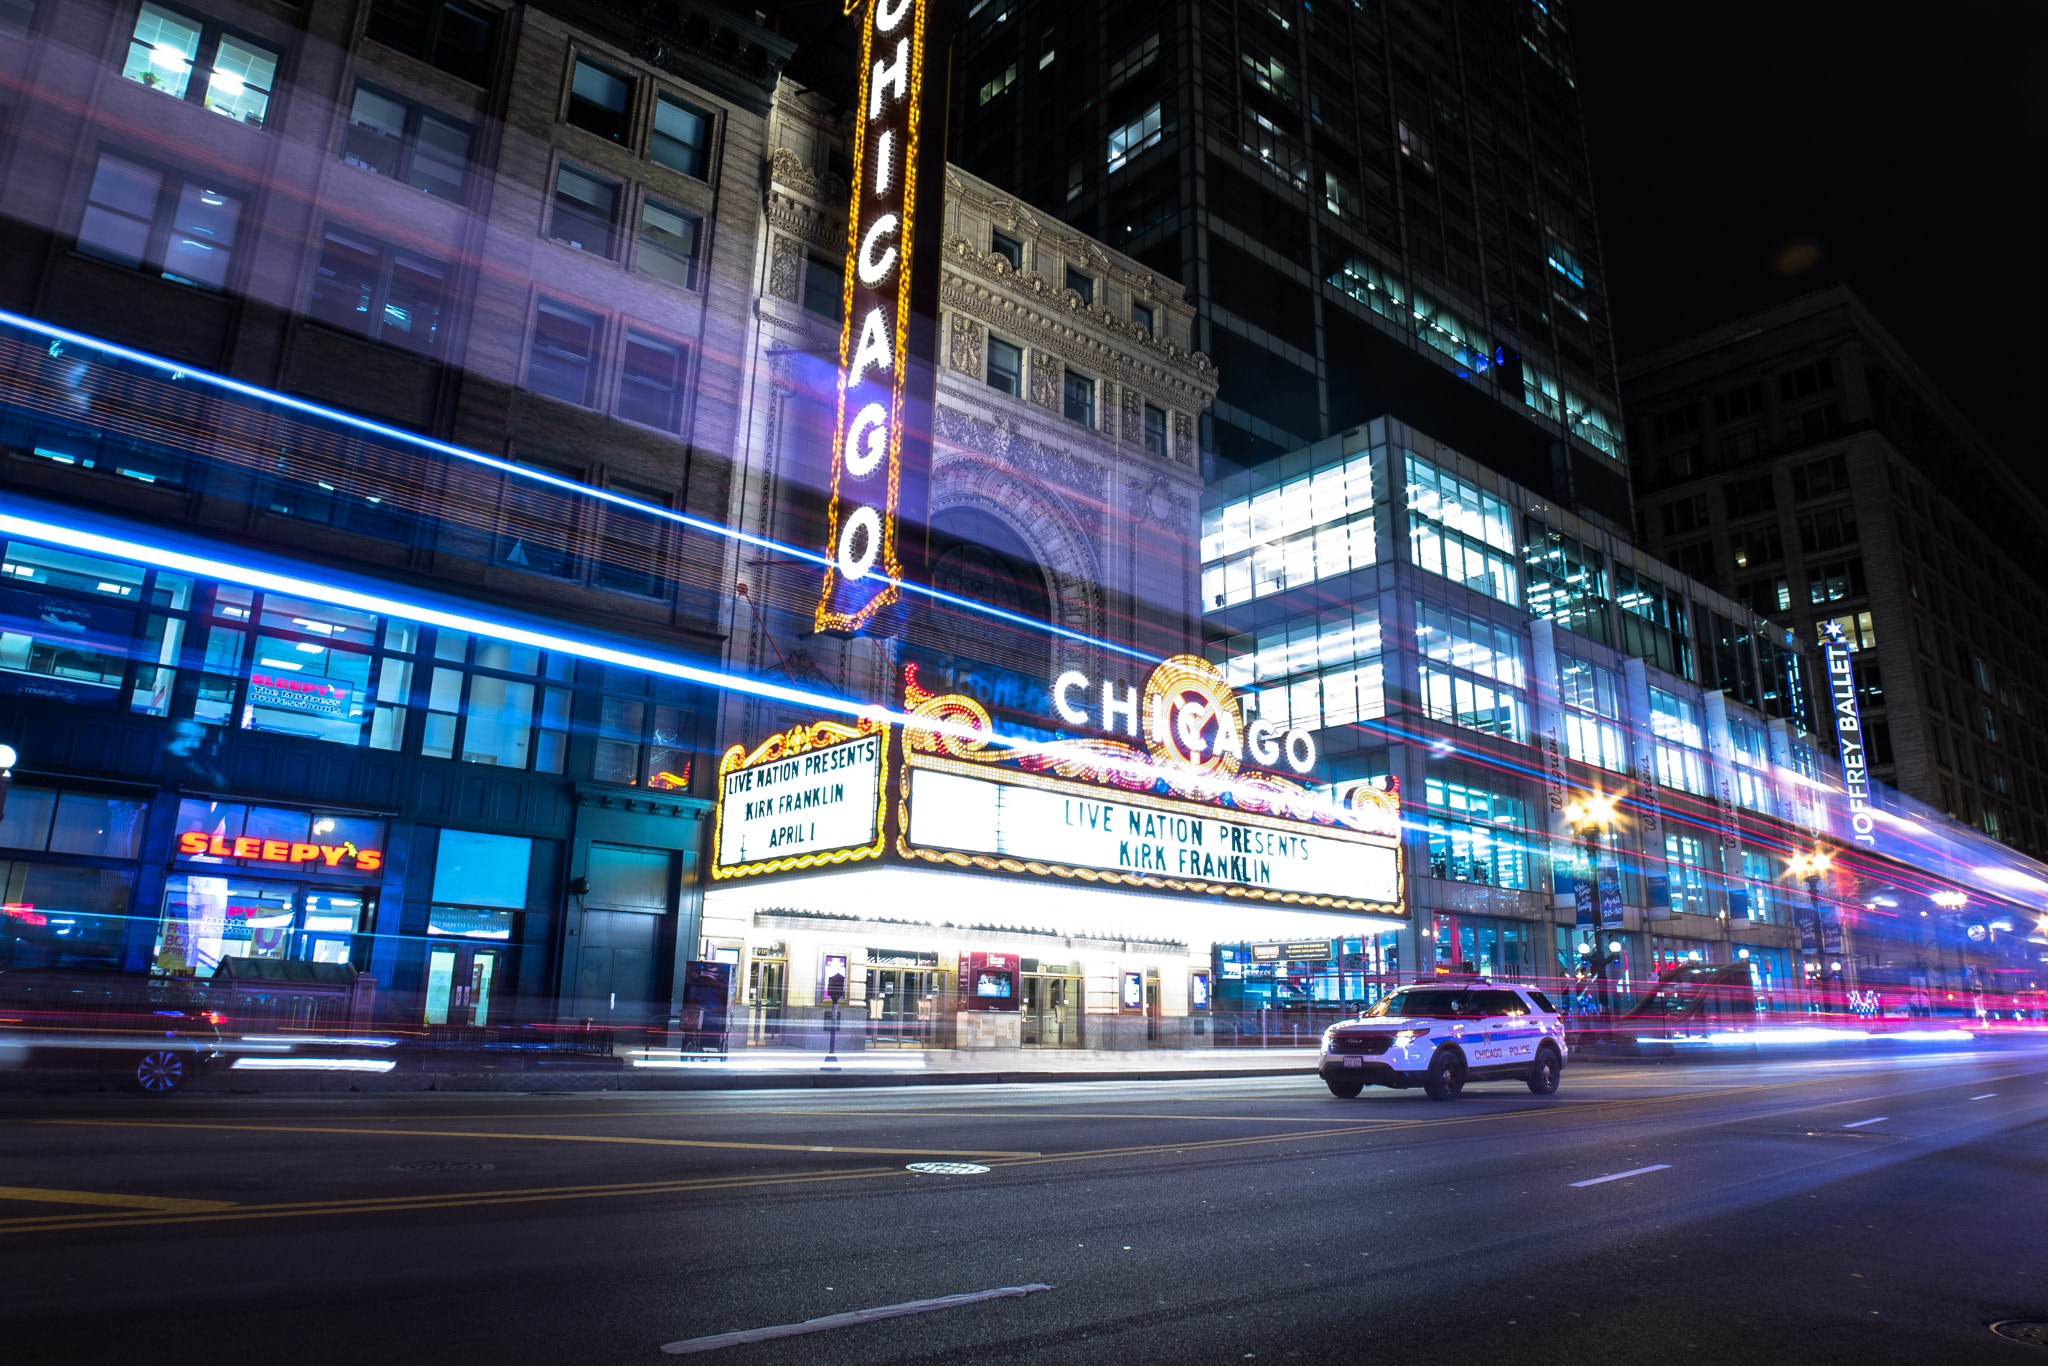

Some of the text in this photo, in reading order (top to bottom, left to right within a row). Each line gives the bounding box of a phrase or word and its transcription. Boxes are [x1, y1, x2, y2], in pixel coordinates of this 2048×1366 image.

[251, 674, 346, 699] SLEEPY'S
[254, 686, 340, 707] The Mattress
[1052, 669, 1316, 774] CHICAGO
[1828, 645, 1875, 847] JOFFREY BALLET
[728, 741, 875, 795] LIVE NATION PRESENTS
[1548, 726, 1565, 813] Walgreens
[745, 783, 844, 821] KIRK FRANKLIN
[769, 823, 804, 848] APRIL
[1065, 800, 1309, 861] LIVE NATION PRESENTS
[180, 831, 382, 871] SLEEPY'S
[1119, 840, 1271, 885] KIRK FRANKLIN
[1603, 895, 1620, 908] April
[1474, 1044, 1531, 1060] CHICAGO POLICE
